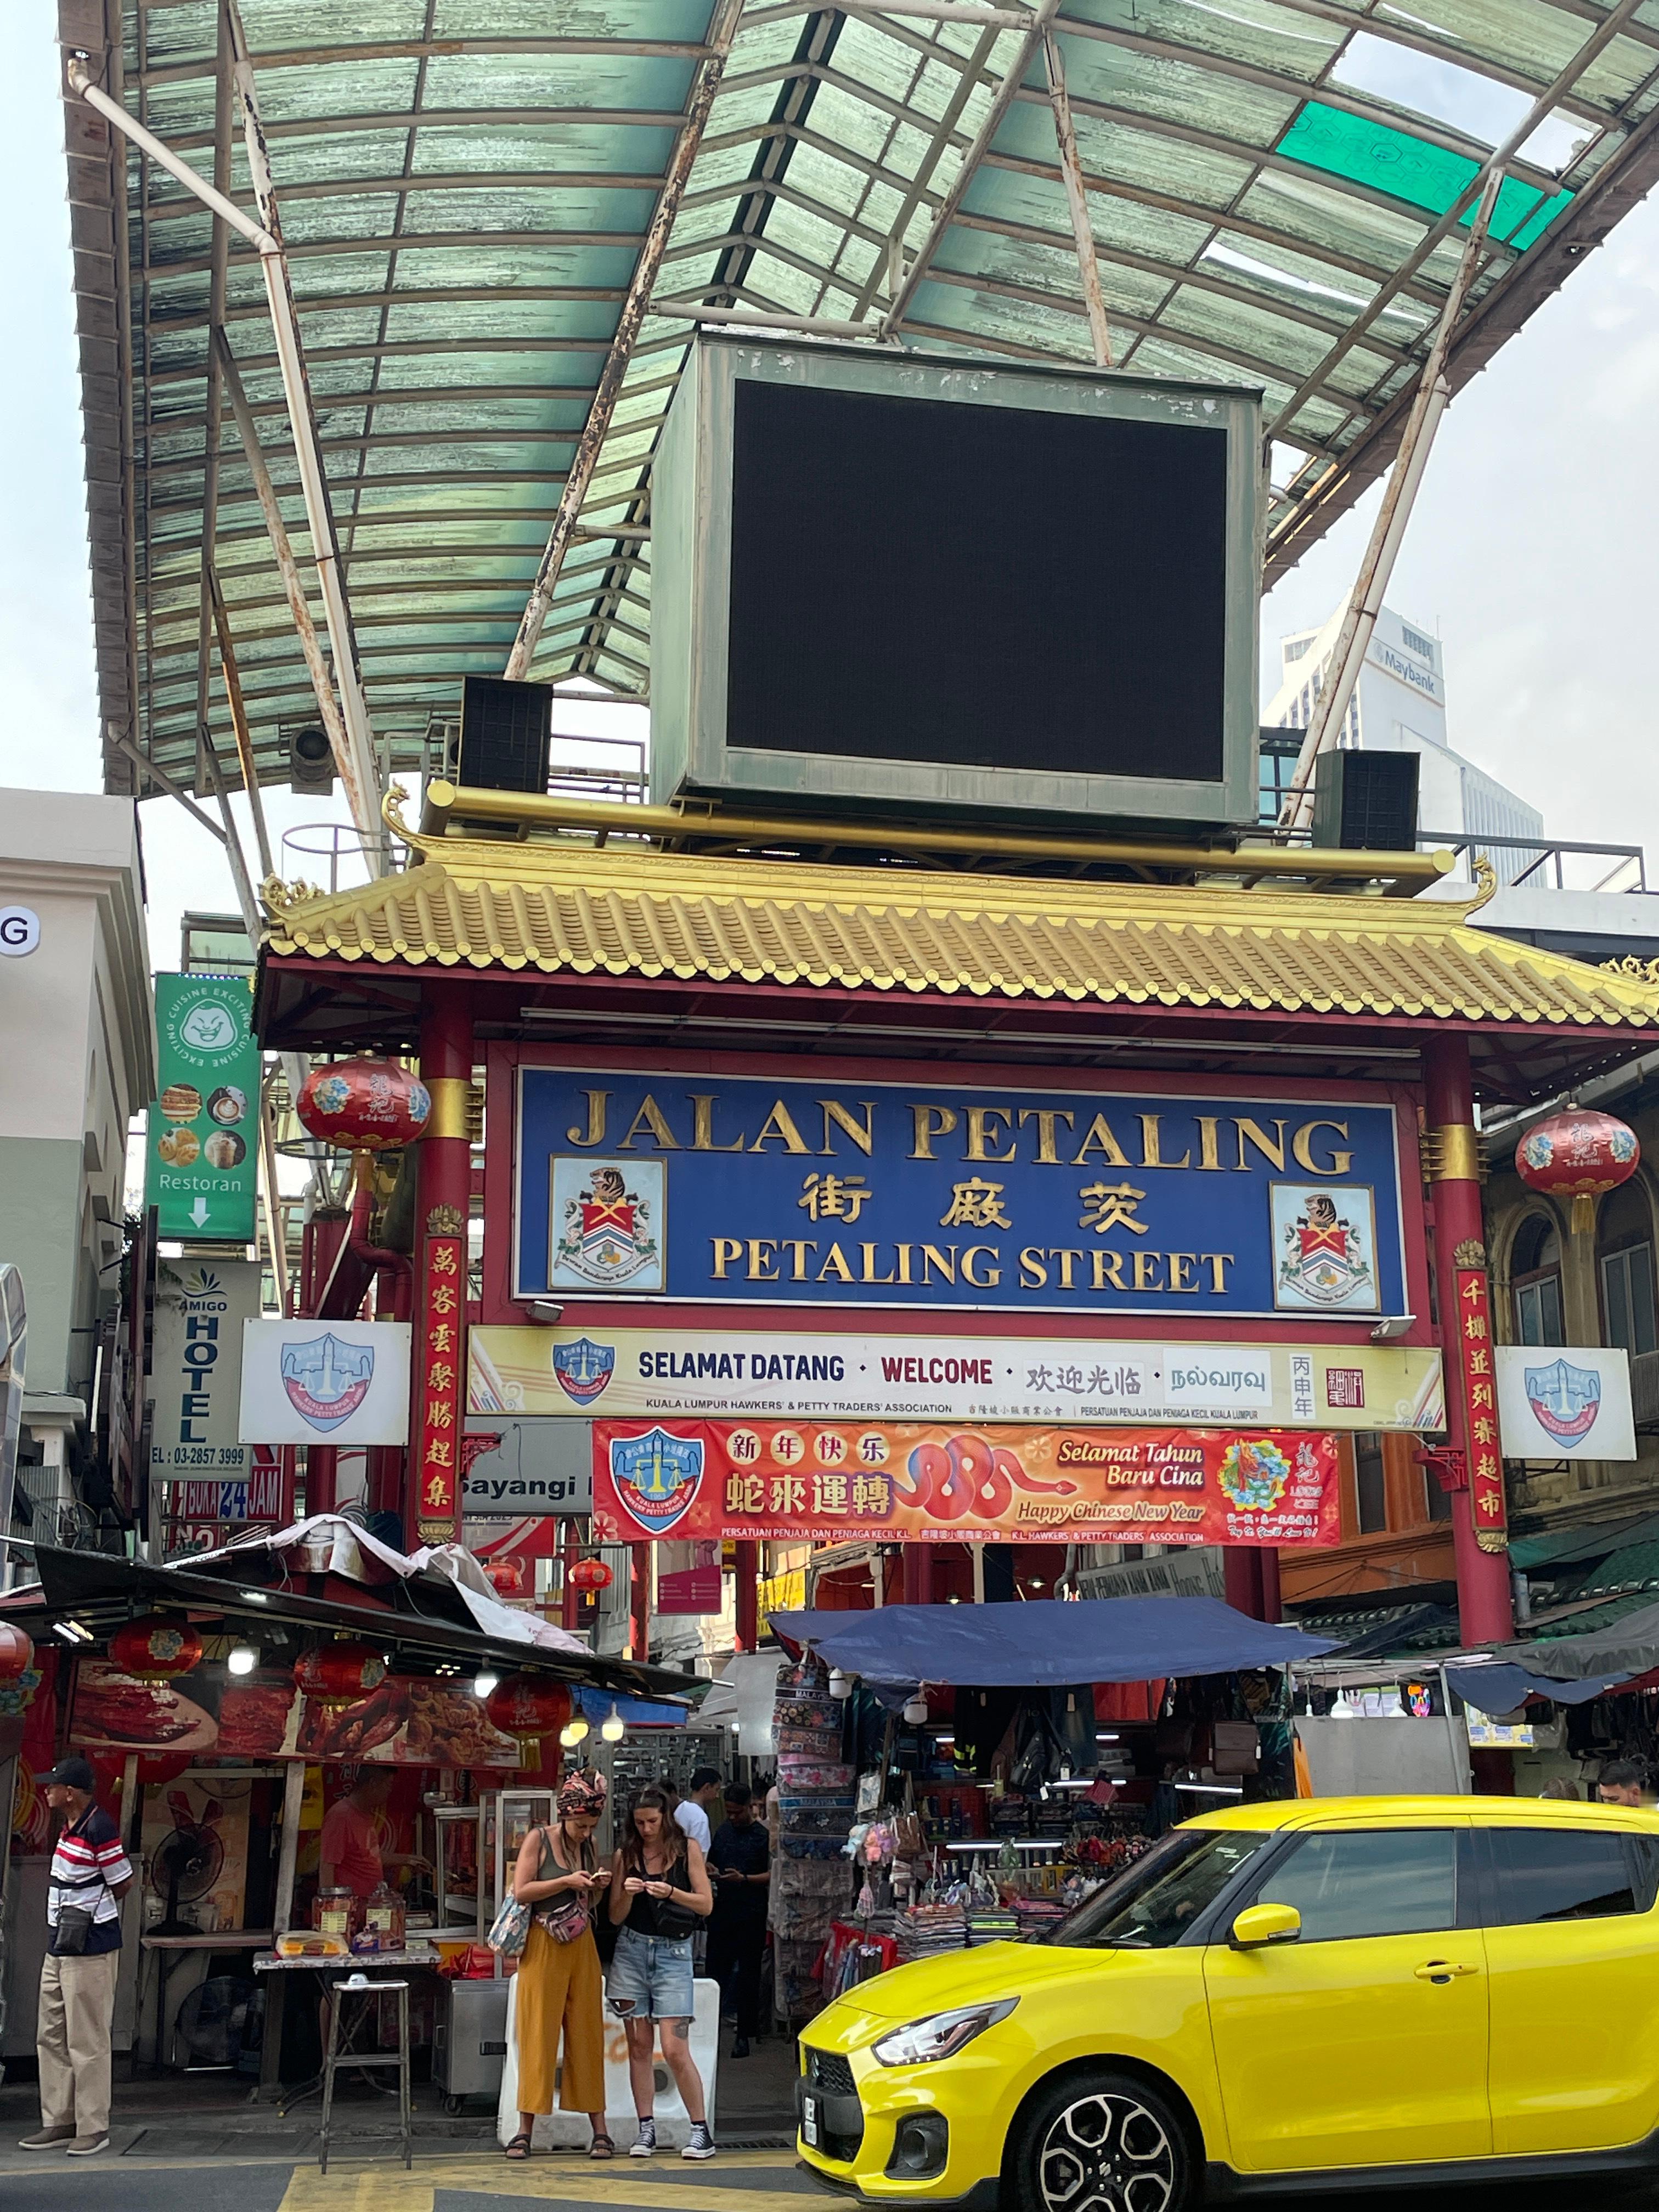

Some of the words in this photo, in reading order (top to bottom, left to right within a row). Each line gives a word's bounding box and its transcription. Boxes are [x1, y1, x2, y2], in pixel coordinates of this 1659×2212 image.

[1385, 650, 1436, 695] Maybank
[0, 917, 28, 944] G
[169, 988, 207, 1018] CUISINE
[213, 988, 252, 1028] EXCITING
[166, 1024, 204, 1066] EXCITING
[212, 1034, 250, 1066] CUISINE
[566, 1090, 878, 1156] JALAN
[906, 1104, 1355, 1176] PETALING
[160, 1174, 241, 1192] Restoran
[709, 1238, 1000, 1288] PETALING
[1019, 1247, 1234, 1294] STREET
[179, 1301, 227, 1311] AMIGO
[180, 1317, 218, 1443] HOTEL
[639, 1352, 746, 1379] SELAMAT
[751, 1354, 844, 1381] DATANG
[882, 1357, 993, 1384] WELCOME
[1026, 1363, 1141, 1396] 欢迎光临
[1171, 1366, 1266, 1392] நல்வரவு
[1292, 1357, 1313, 1417] 丙申年
[646, 1399, 681, 1408] KUALA
[685, 1400, 728, 1409] LUMPUR
[798, 1402, 830, 1410] PETTY
[833, 1402, 883, 1412] TRADERS'
[885, 1403, 952, 1413] ASSOCIATION
[1081, 1406, 1118, 1417] PERSATUAN
[1119, 1407, 1147, 1417] PENJAJA
[1149, 1408, 1161, 1417] DAN
[1163, 1408, 1190, 1418] PENIAGA
[1191, 1409, 1209, 1419] KECIL
[1210, 1410, 1231, 1419] KUALA
[1233, 1410, 1258, 1420] LUMPUR
[152, 1448, 163, 1463] EL
[174, 1448, 215, 1464] 03-2857
[218, 1448, 244, 1464] 3999
[732, 1435, 886, 1460] 新年快乐
[1059, 1442, 1139, 1463] Selamat
[1147, 1443, 1203, 1463] Tahun
[1107, 1466, 1155, 1485] Baru
[1160, 1466, 1203, 1486] Cina
[189, 1482, 216, 1514] BUKA
[219, 1482, 246, 1519] 24
[249, 1471, 278, 1515] JAM
[726, 1473, 890, 1515] 蛇來運轉
[1019, 1502, 1068, 1524] Happy
[1074, 1502, 1131, 1520] Chinese
[1136, 1503, 1167, 1520] New
[1172, 1503, 1203, 1520] Year
[721, 1527, 771, 1537] PERSATUAN
[774, 1528, 810, 1537] PENJAJA
[811, 1529, 828, 1538] DAN
[833, 1530, 870, 1538] PENIAGA
[871, 1530, 895, 1538] KECIL
[1081, 1532, 1107, 1541] PETTY
[1150, 1532, 1203, 1542] ASSOCIATION
